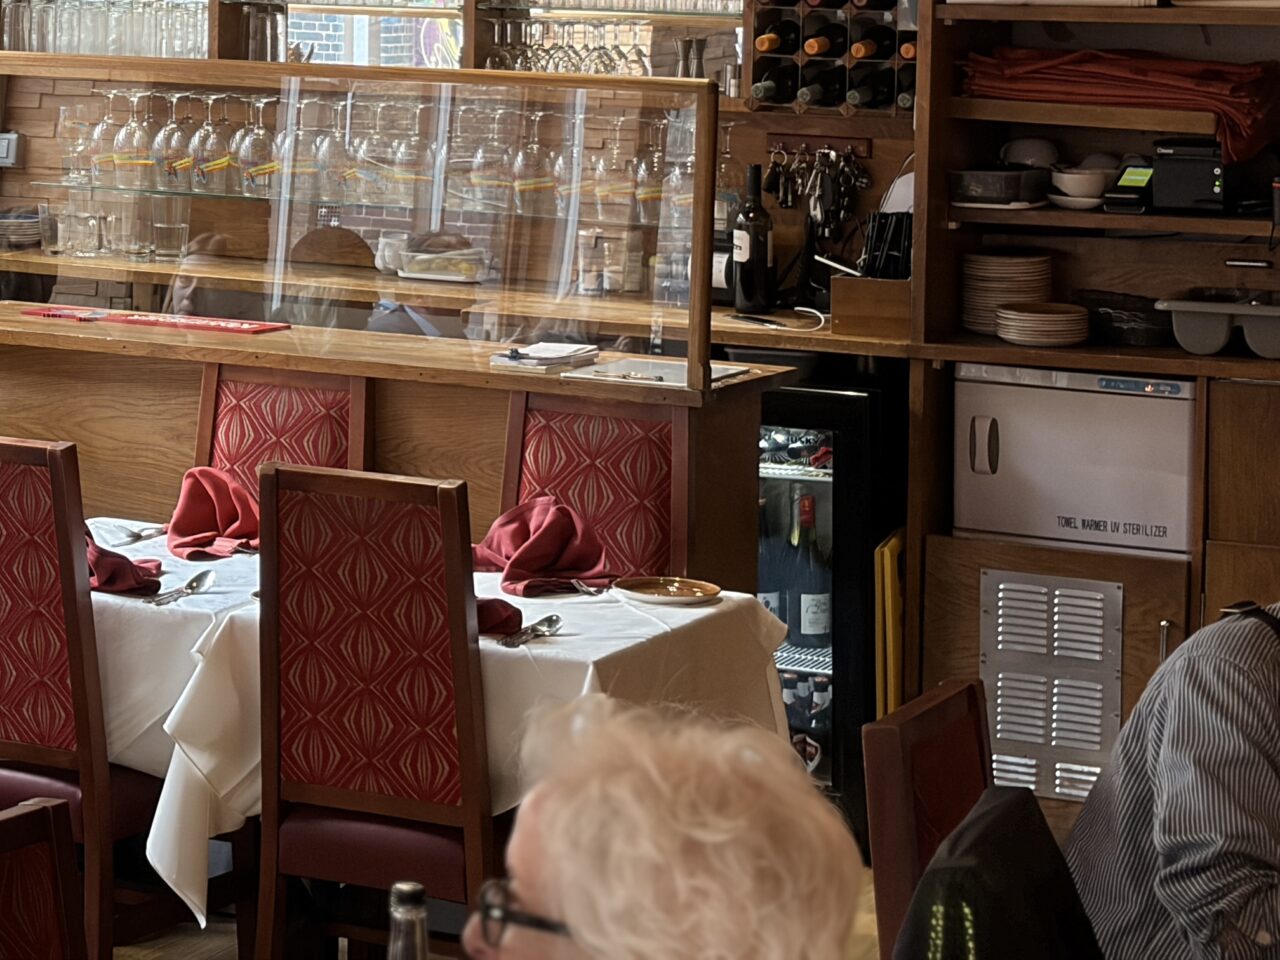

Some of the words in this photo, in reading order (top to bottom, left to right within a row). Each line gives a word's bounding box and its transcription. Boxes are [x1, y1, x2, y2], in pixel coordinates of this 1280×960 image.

[1057, 515, 1078, 529] TOWEL
[1081, 518, 1107, 532] WARMER
[1111, 521, 1120, 533] UV
[1123, 522, 1167, 538] STERILIZER
